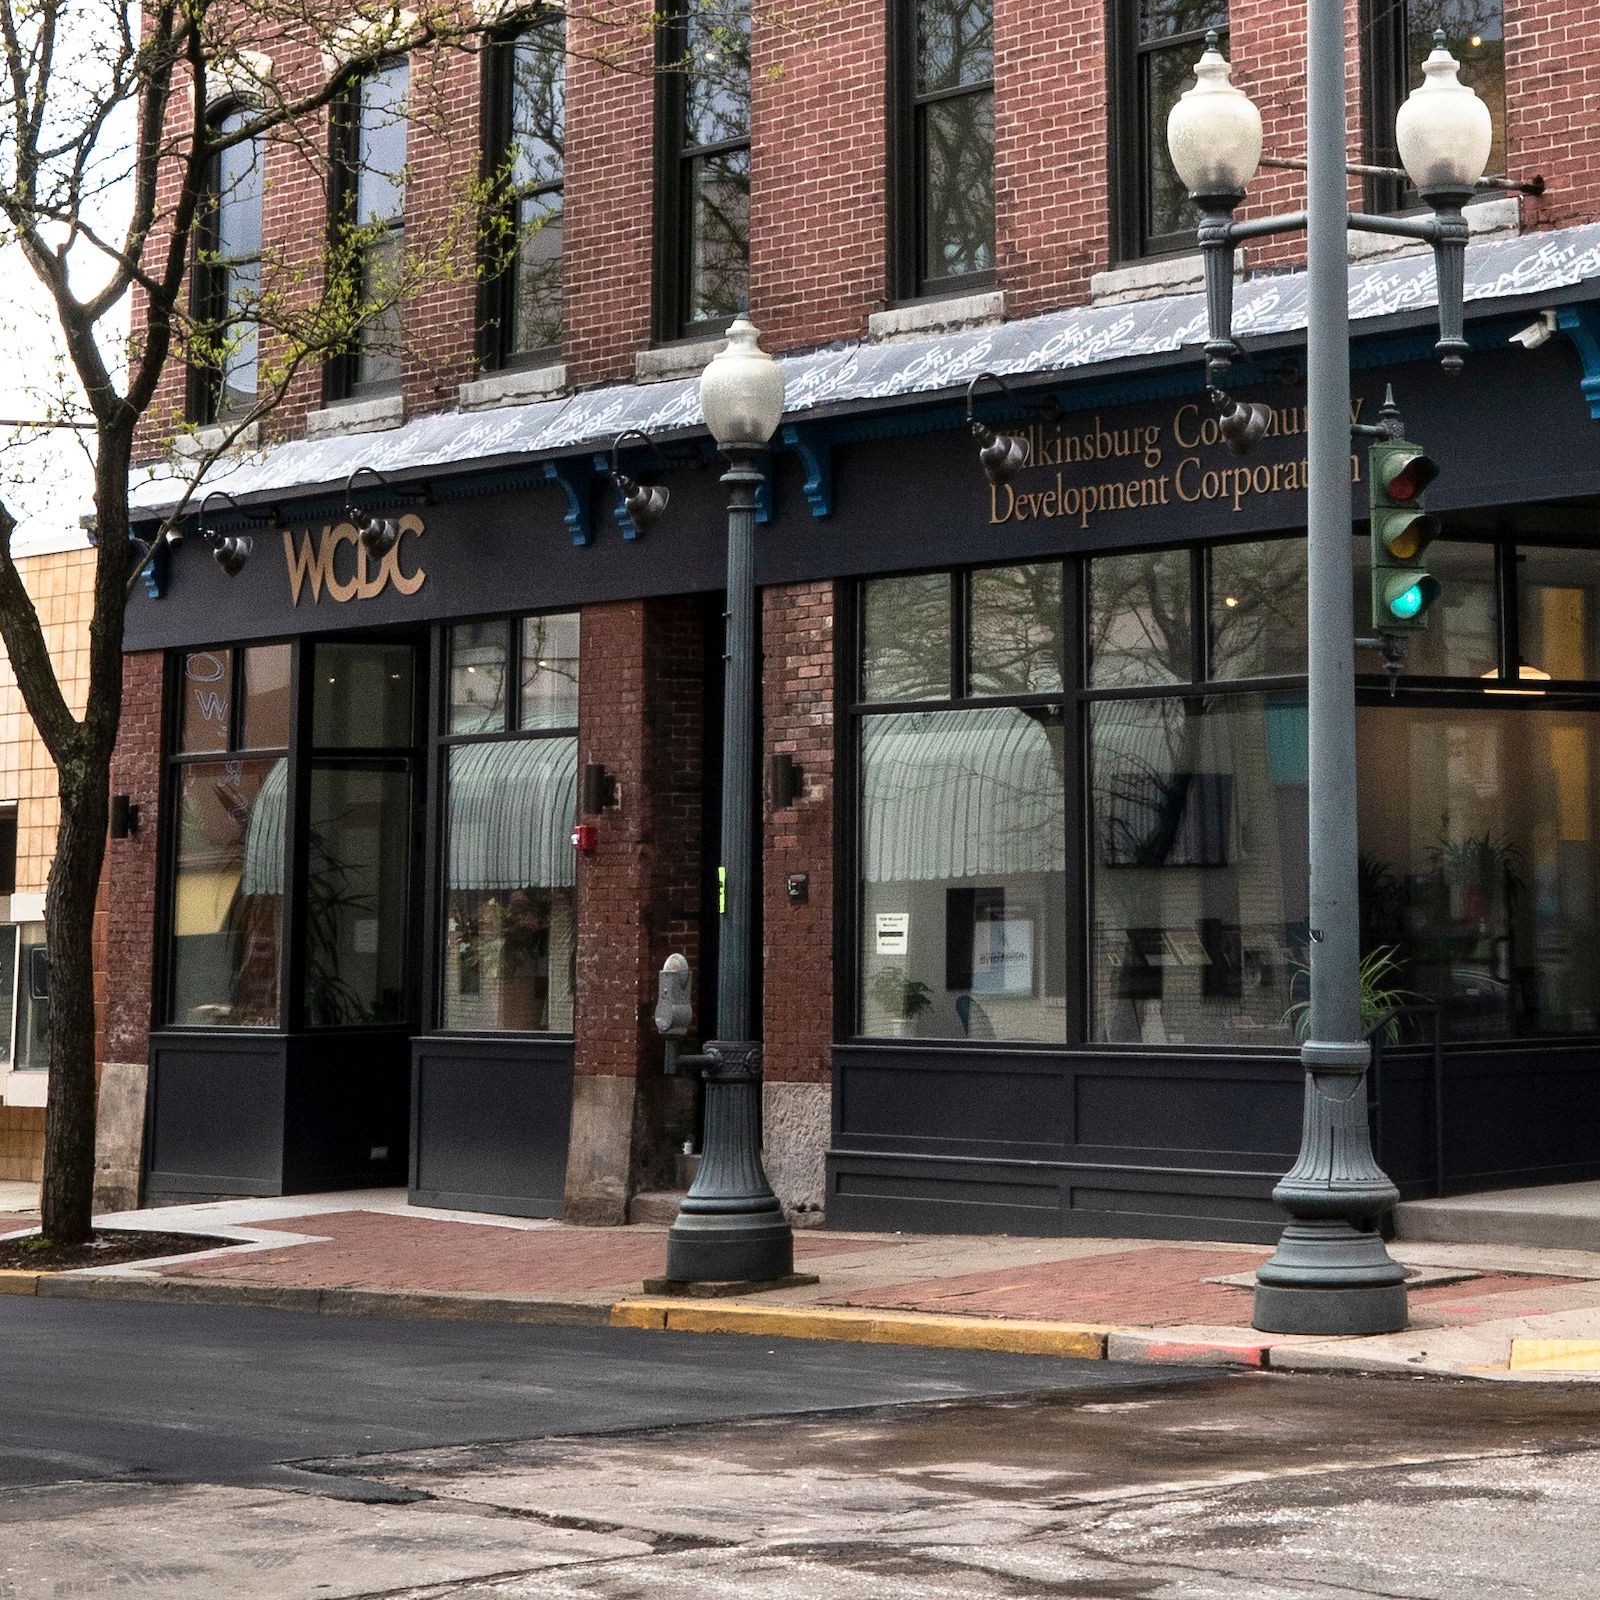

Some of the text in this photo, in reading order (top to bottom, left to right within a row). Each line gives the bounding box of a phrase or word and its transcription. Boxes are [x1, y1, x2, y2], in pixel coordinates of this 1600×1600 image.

[989, 457, 1361, 529] Development Corporatn
[283, 514, 426, 607] WCDC
